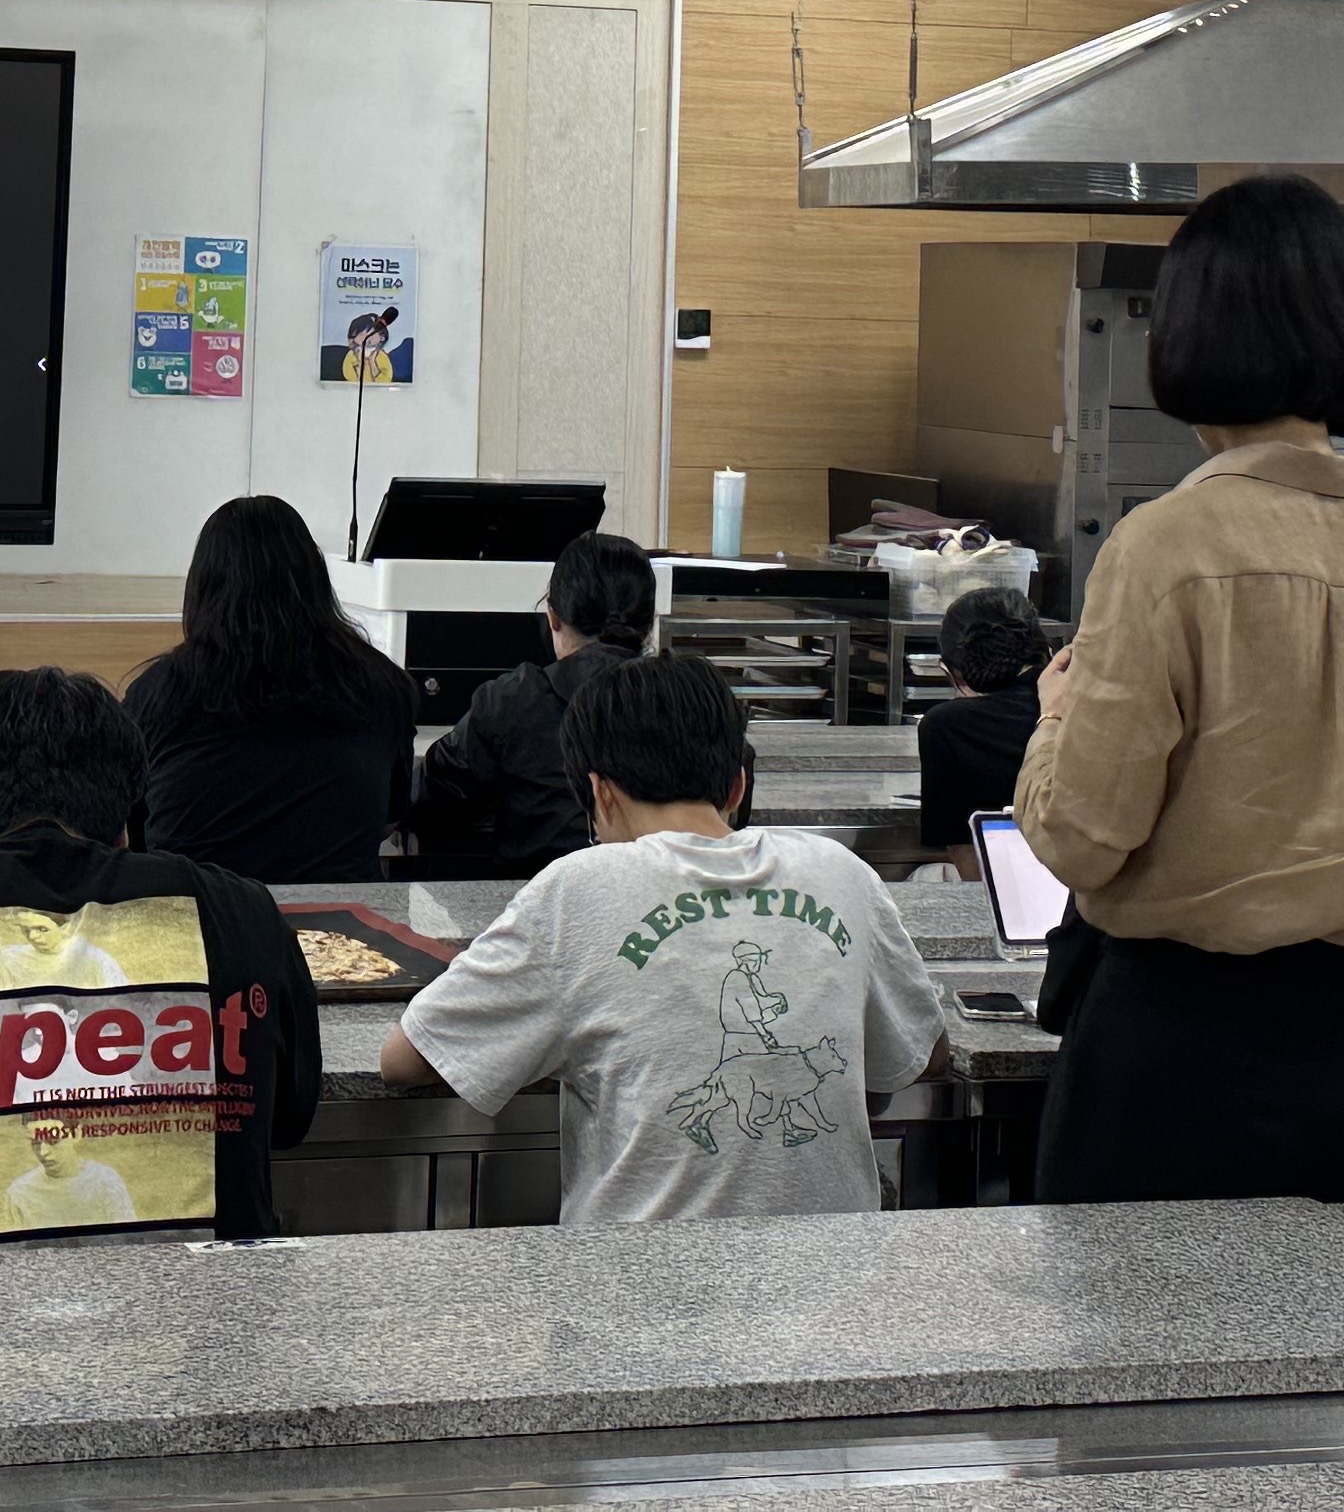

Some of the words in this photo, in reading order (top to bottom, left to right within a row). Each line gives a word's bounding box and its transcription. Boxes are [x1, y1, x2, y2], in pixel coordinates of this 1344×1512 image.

[342, 258, 400, 274] 마스크는
[617, 888, 732, 970] REST
[747, 888, 851, 958] TIME
[66, 1087, 96, 1100] NOT
